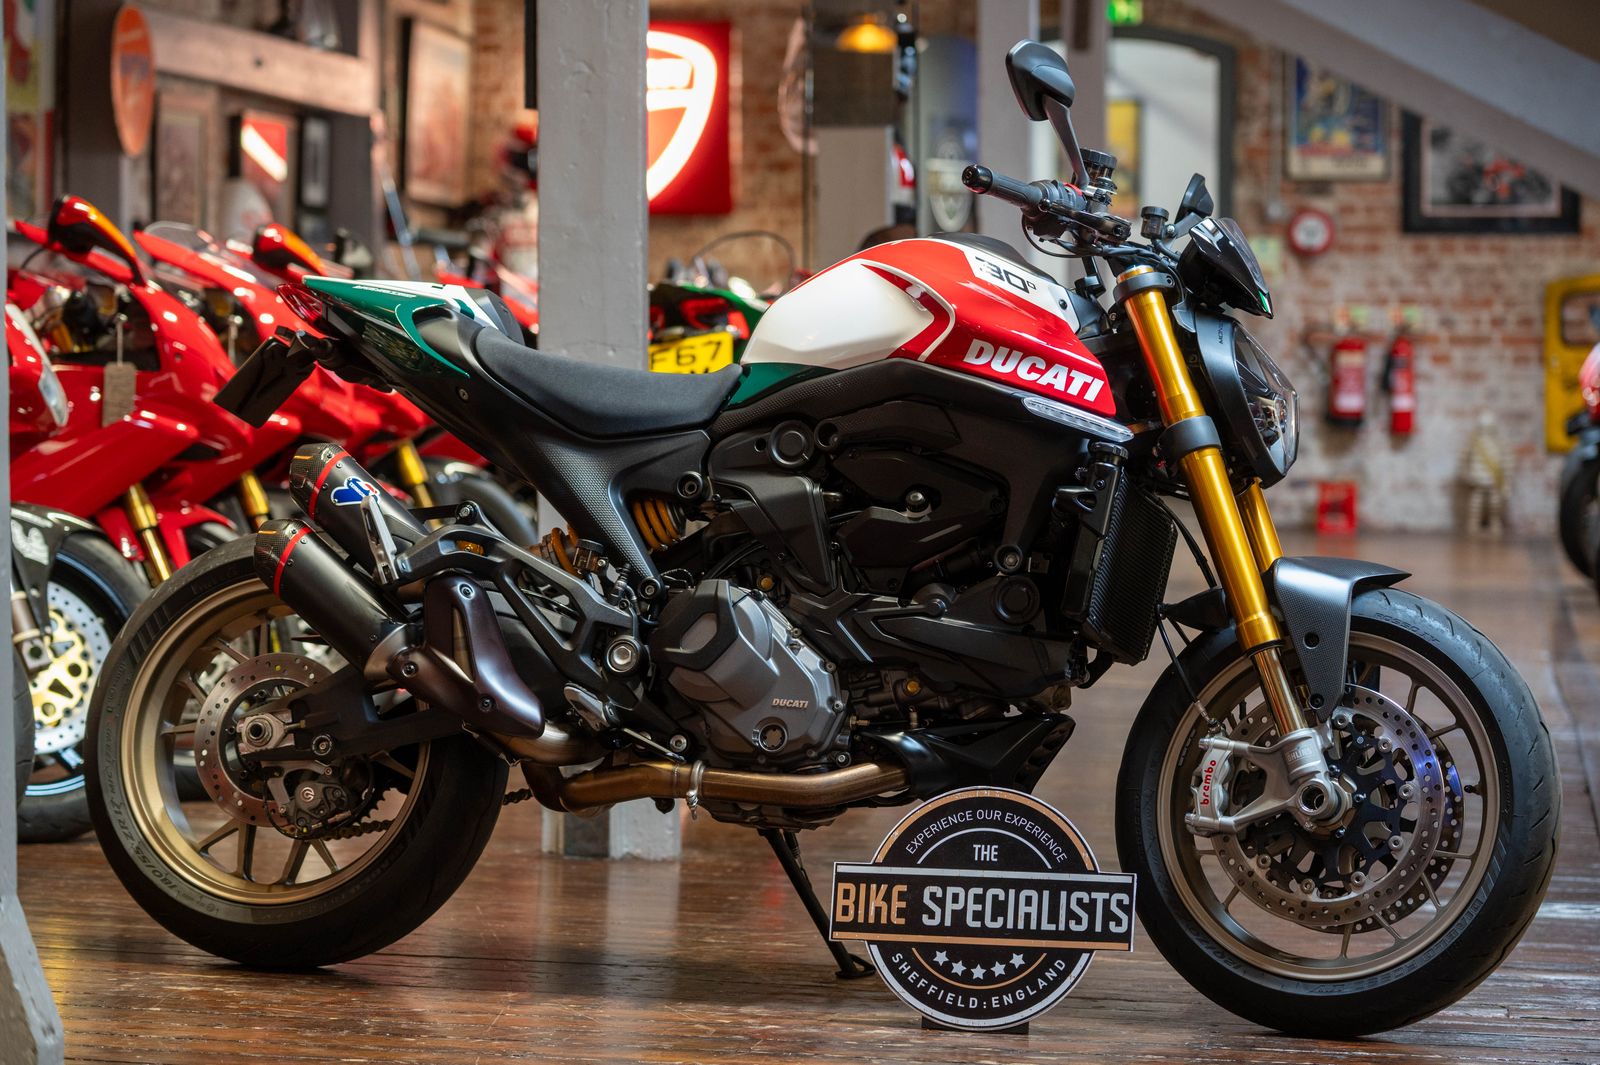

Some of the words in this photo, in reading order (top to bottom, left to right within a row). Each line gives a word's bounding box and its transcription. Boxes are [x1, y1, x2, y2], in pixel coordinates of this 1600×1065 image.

[963, 338, 1105, 402] DUCATI
[771, 698, 809, 709] DUCATI
[1200, 760, 1217, 806] brembo
[905, 810, 974, 855] EXPERIENCE
[976, 809, 1001, 820] OUR
[1004, 812, 1068, 863] EXPERIENCE
[973, 844, 999, 862] THE
[835, 882, 908, 925] BIKE
[921, 886, 1130, 934] SPECIALISTS
